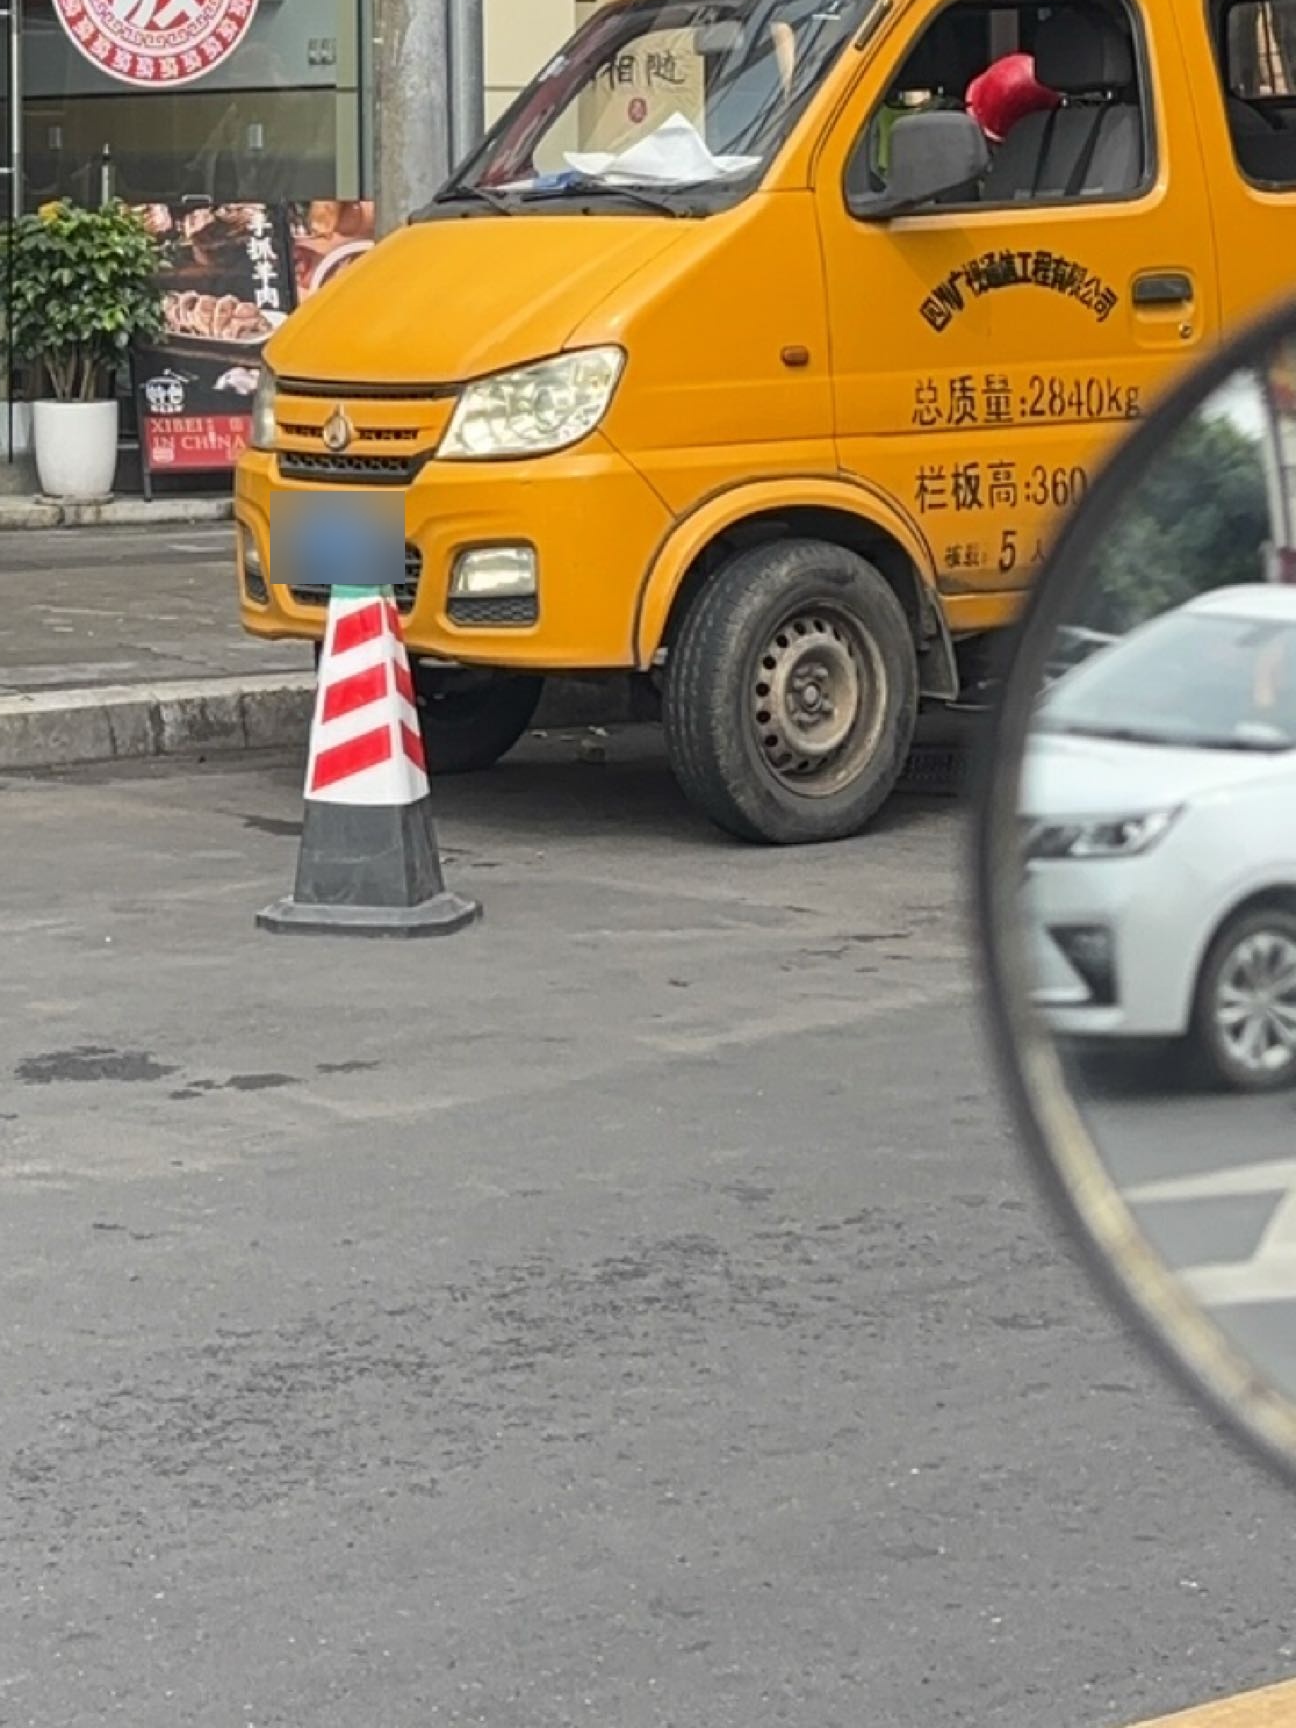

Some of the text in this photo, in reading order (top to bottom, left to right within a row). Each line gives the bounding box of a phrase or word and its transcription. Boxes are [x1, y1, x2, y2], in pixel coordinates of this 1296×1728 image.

[246, 203, 281, 309] 手抓羊肉
[912, 374, 1141, 425] 总质量:2840kg
